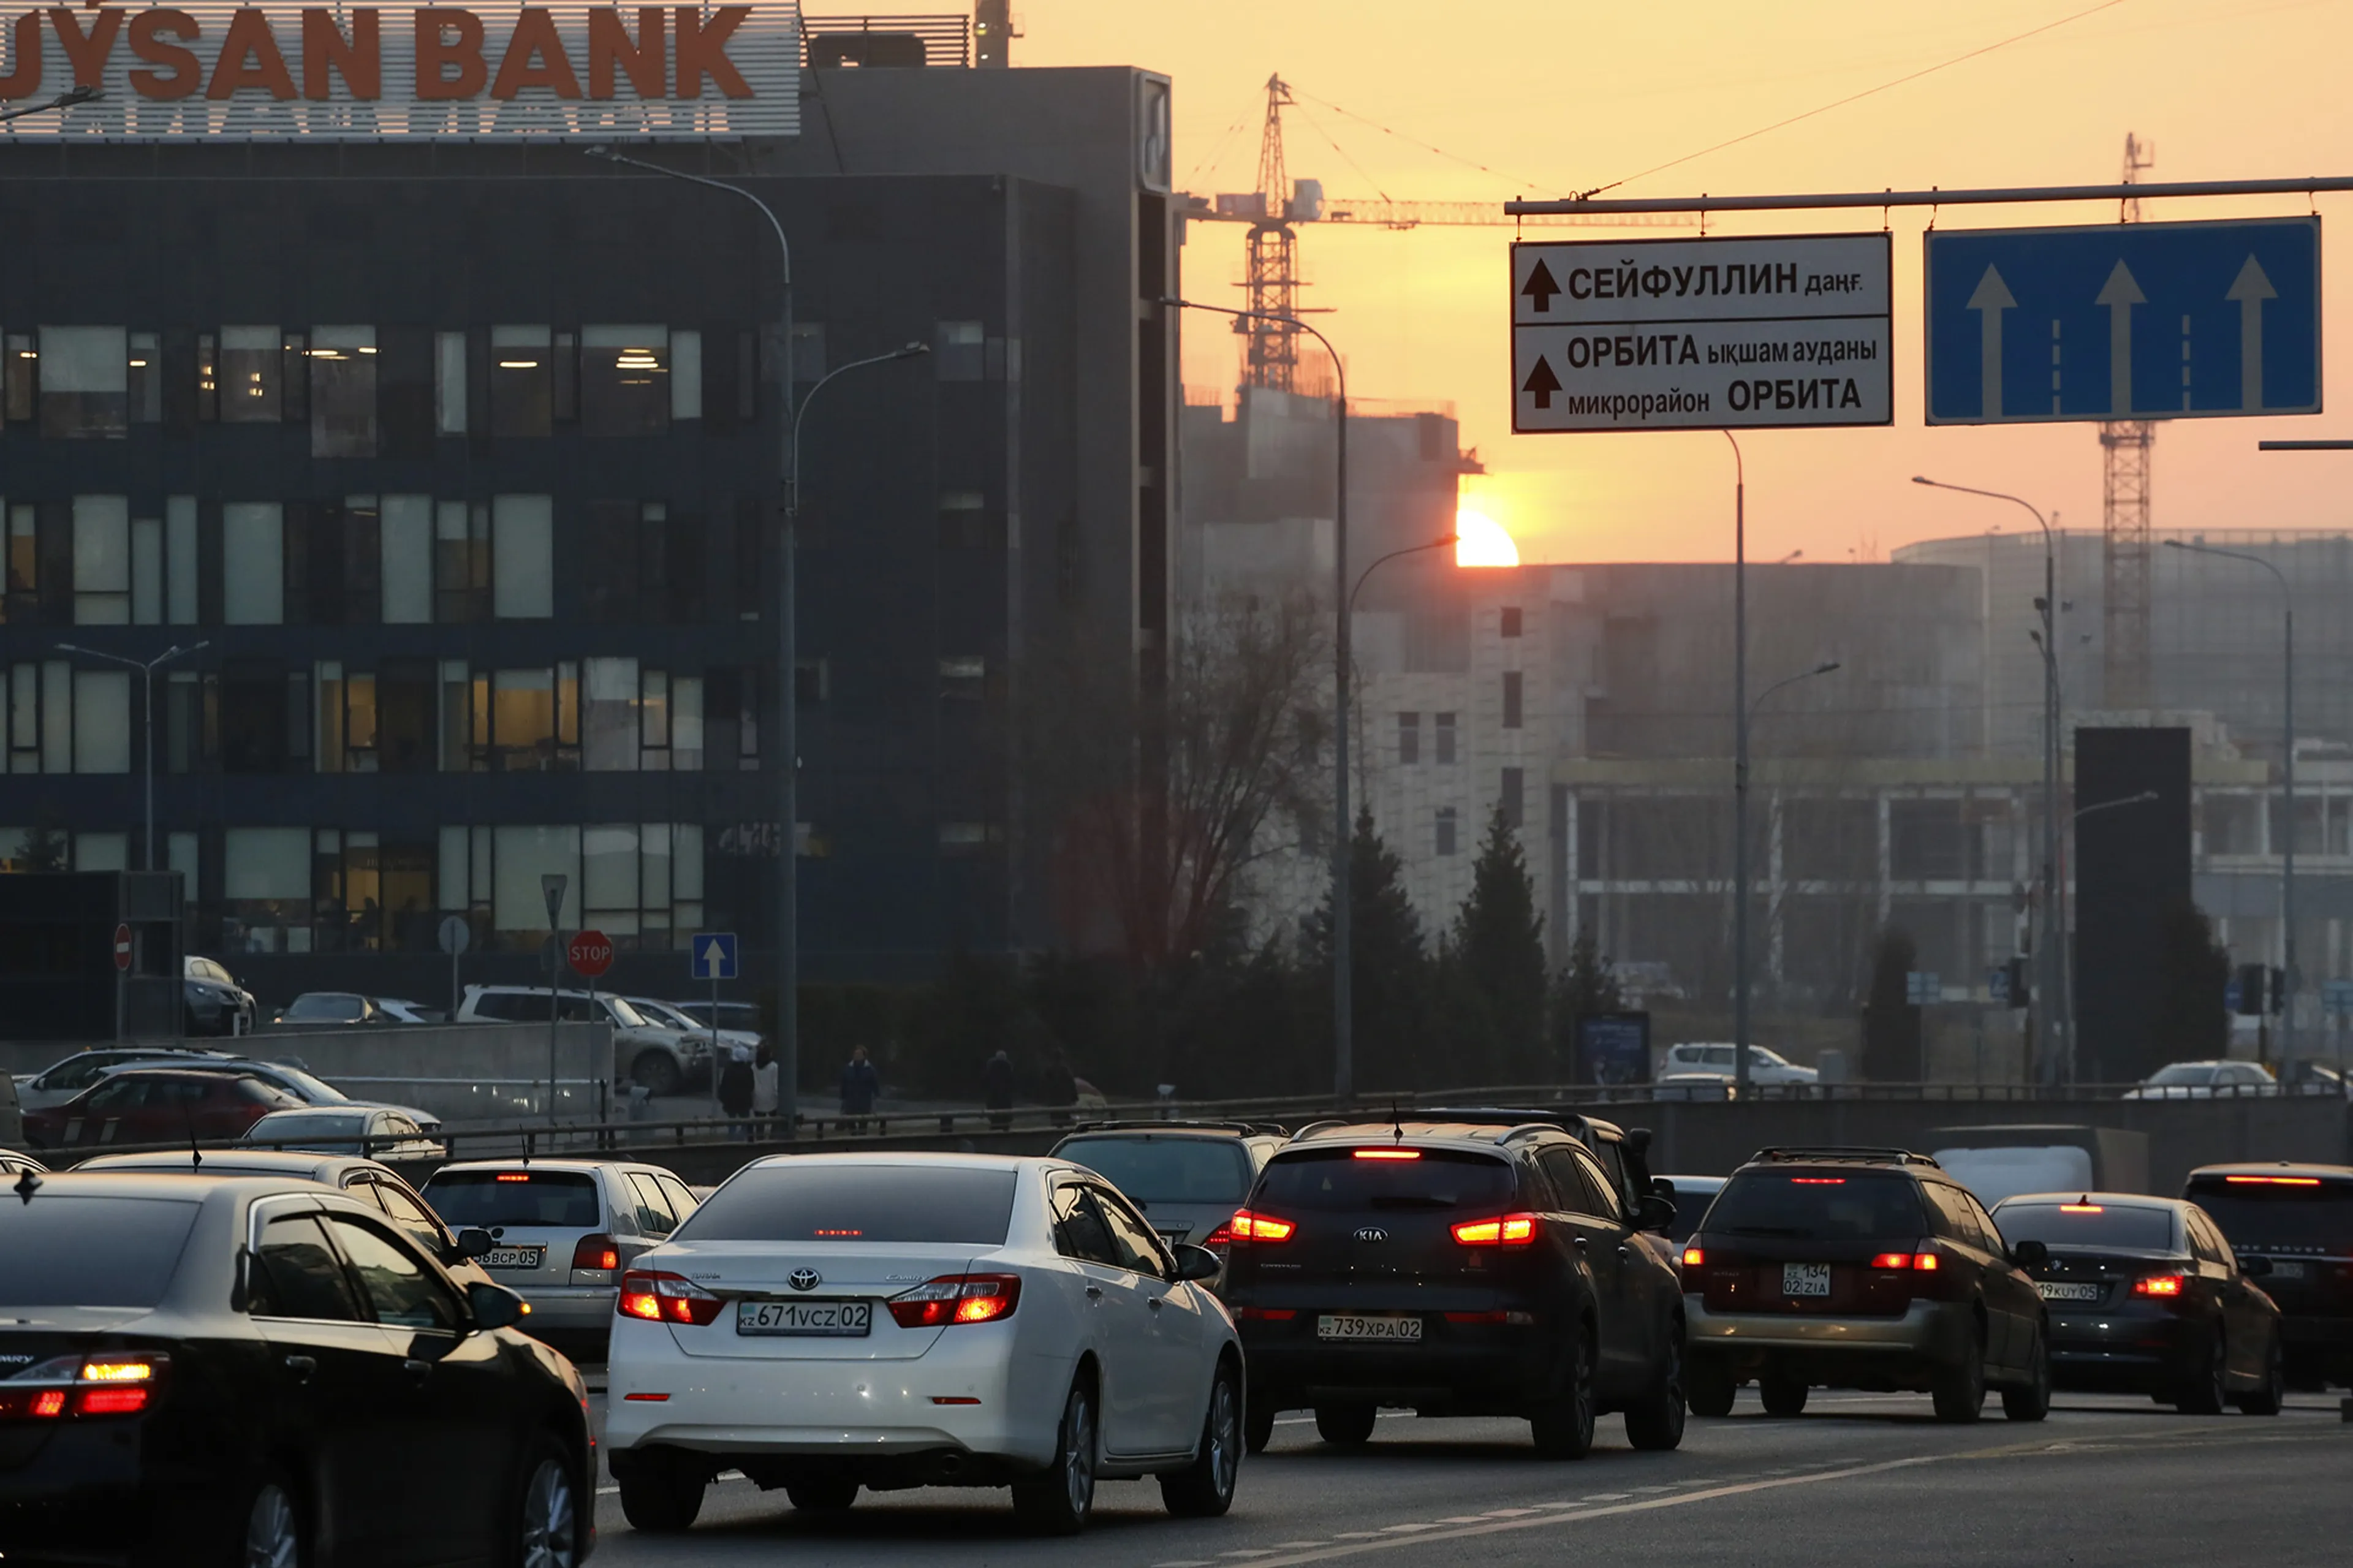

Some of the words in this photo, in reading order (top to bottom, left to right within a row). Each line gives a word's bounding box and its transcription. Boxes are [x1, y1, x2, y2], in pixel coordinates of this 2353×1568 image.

[415, 7, 755, 100] BANK
[1569, 259, 1797, 300] СЕЙФУЛЛИН
[1805, 274, 1863, 296] даңғ.
[1567, 335, 1700, 368] ОРБИТА
[1708, 342, 1788, 366] ықшам
[1793, 340, 1876, 365] ауданы
[1569, 387, 1709, 420] микрорайон
[1728, 378, 1862, 411] ОРБИТА
[571, 946, 610, 961] STOP
[1359, 1230, 1382, 1241] KIA
[473, 1253, 516, 1263] 6BCP
[520, 1251, 537, 1263] 05
[1803, 1264, 1828, 1278] 134
[1784, 1280, 1800, 1293] 02
[1805, 1282, 1826, 1293] ZIA
[2039, 1284, 2077, 1297] 19KUY
[2080, 1286, 2096, 1298] 05
[758, 1306, 836, 1327] 671VCZ
[841, 1306, 867, 1327] 02
[1334, 1318, 1395, 1336] 739XPA
[1400, 1320, 1420, 1337] 02
